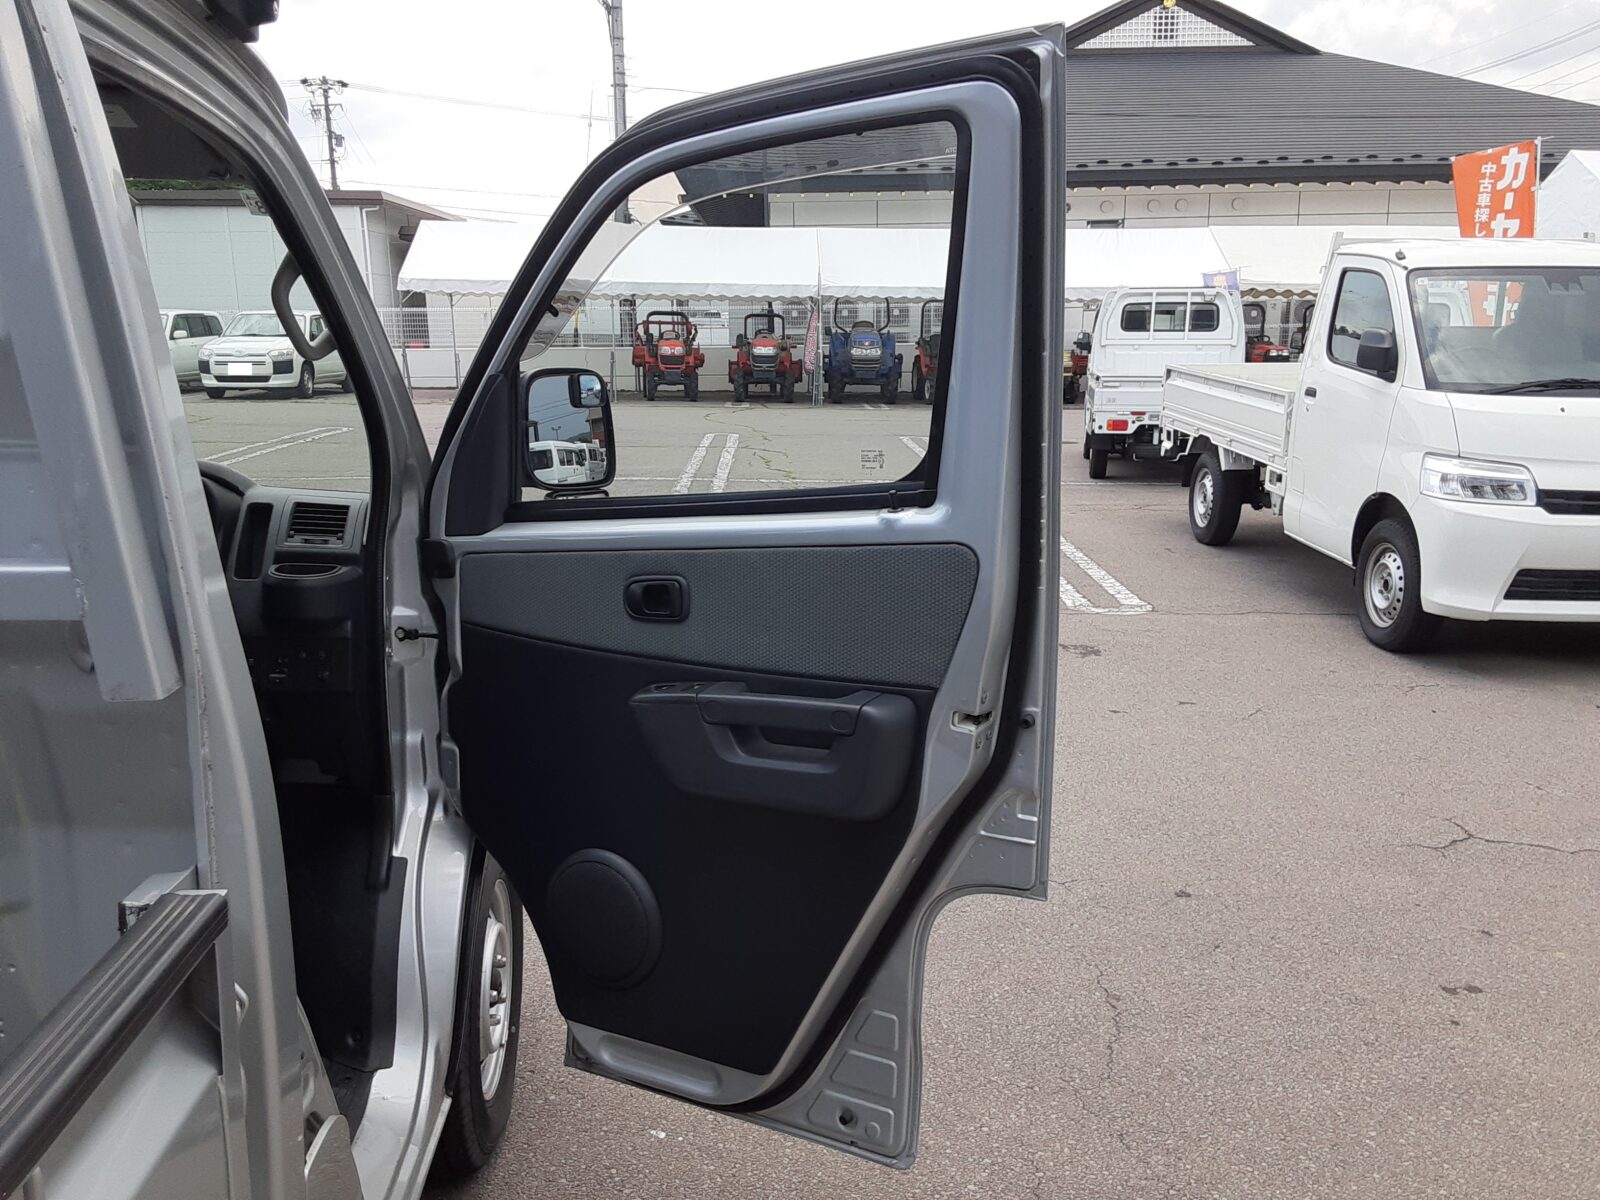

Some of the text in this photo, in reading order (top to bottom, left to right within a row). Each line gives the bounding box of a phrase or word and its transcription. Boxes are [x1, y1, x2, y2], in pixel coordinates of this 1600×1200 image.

[1474, 162, 1497, 237] 中古車探し
